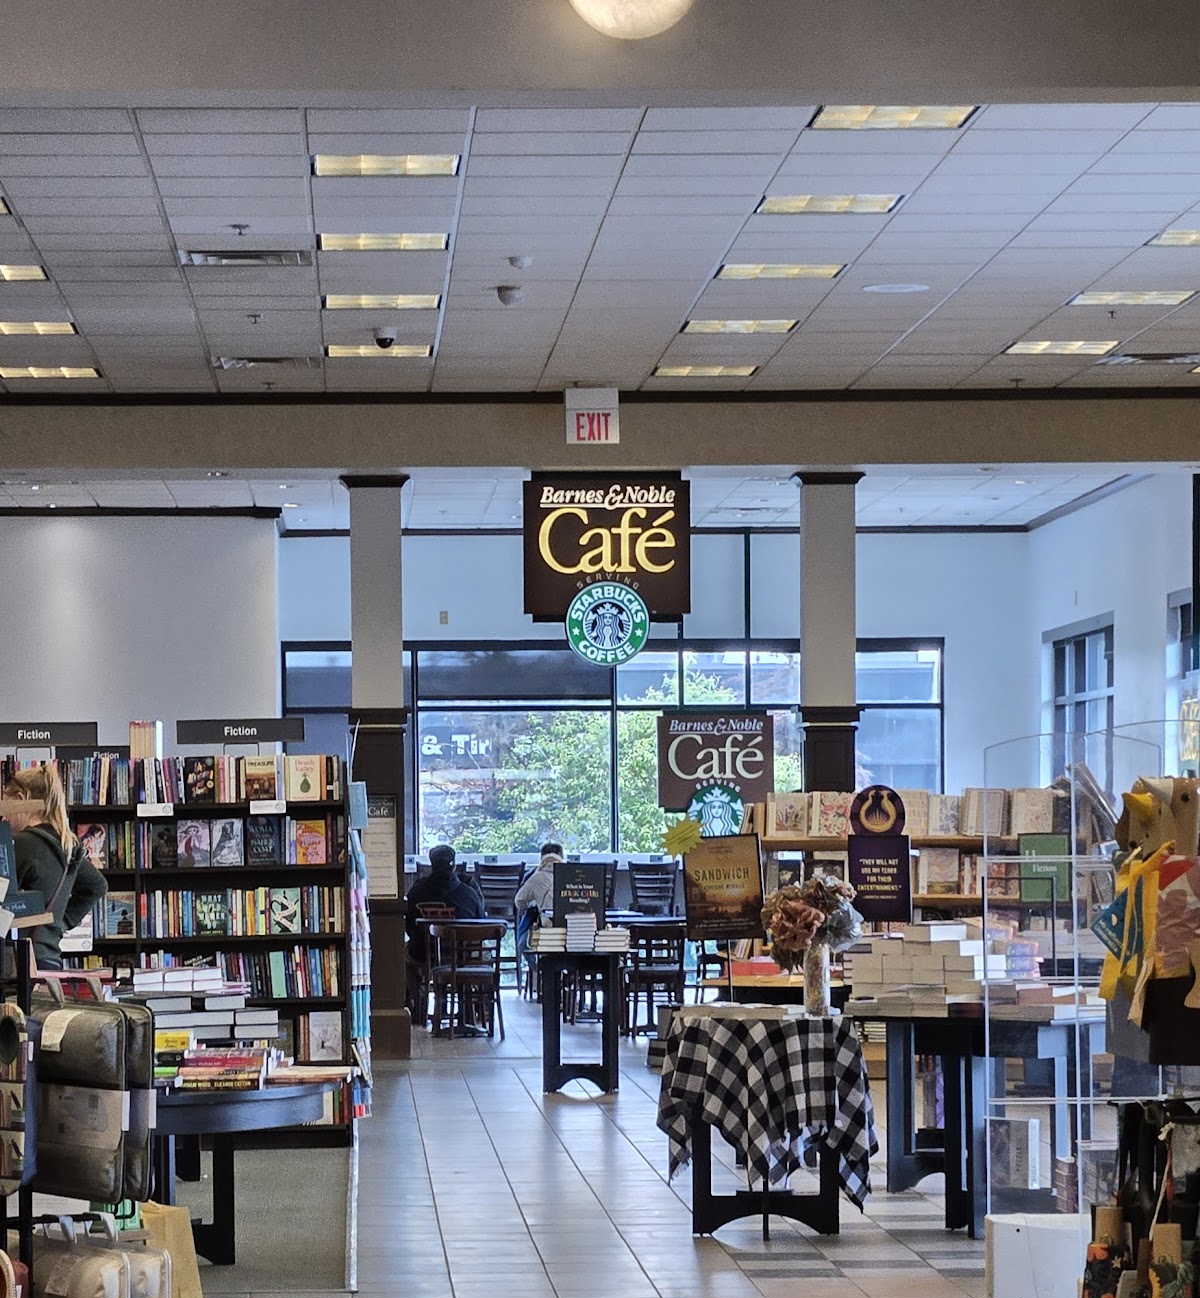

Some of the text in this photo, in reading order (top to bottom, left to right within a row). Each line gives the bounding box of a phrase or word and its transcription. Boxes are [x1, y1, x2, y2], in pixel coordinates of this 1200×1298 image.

[576, 412, 611, 441] EXIT
[541, 484, 676, 510] Barnes & Noble
[538, 506, 676, 574] Café
[576, 572, 640, 590] SERVING
[571, 586, 646, 623] STARBUCKS
[578, 640, 635, 662] COFFEE
[17, 729, 51, 740] Fiction
[224, 726, 257, 736] Fiction
[669, 718, 764, 736] Barnes & Noble
[421, 734, 443, 755] &
[93, 751, 119, 760] Fiction
[668, 734, 764, 780] Café
[695, 779, 741, 793] SERVING
[368, 806, 390, 817] Café
[694, 866, 750, 882] SANDWICH
